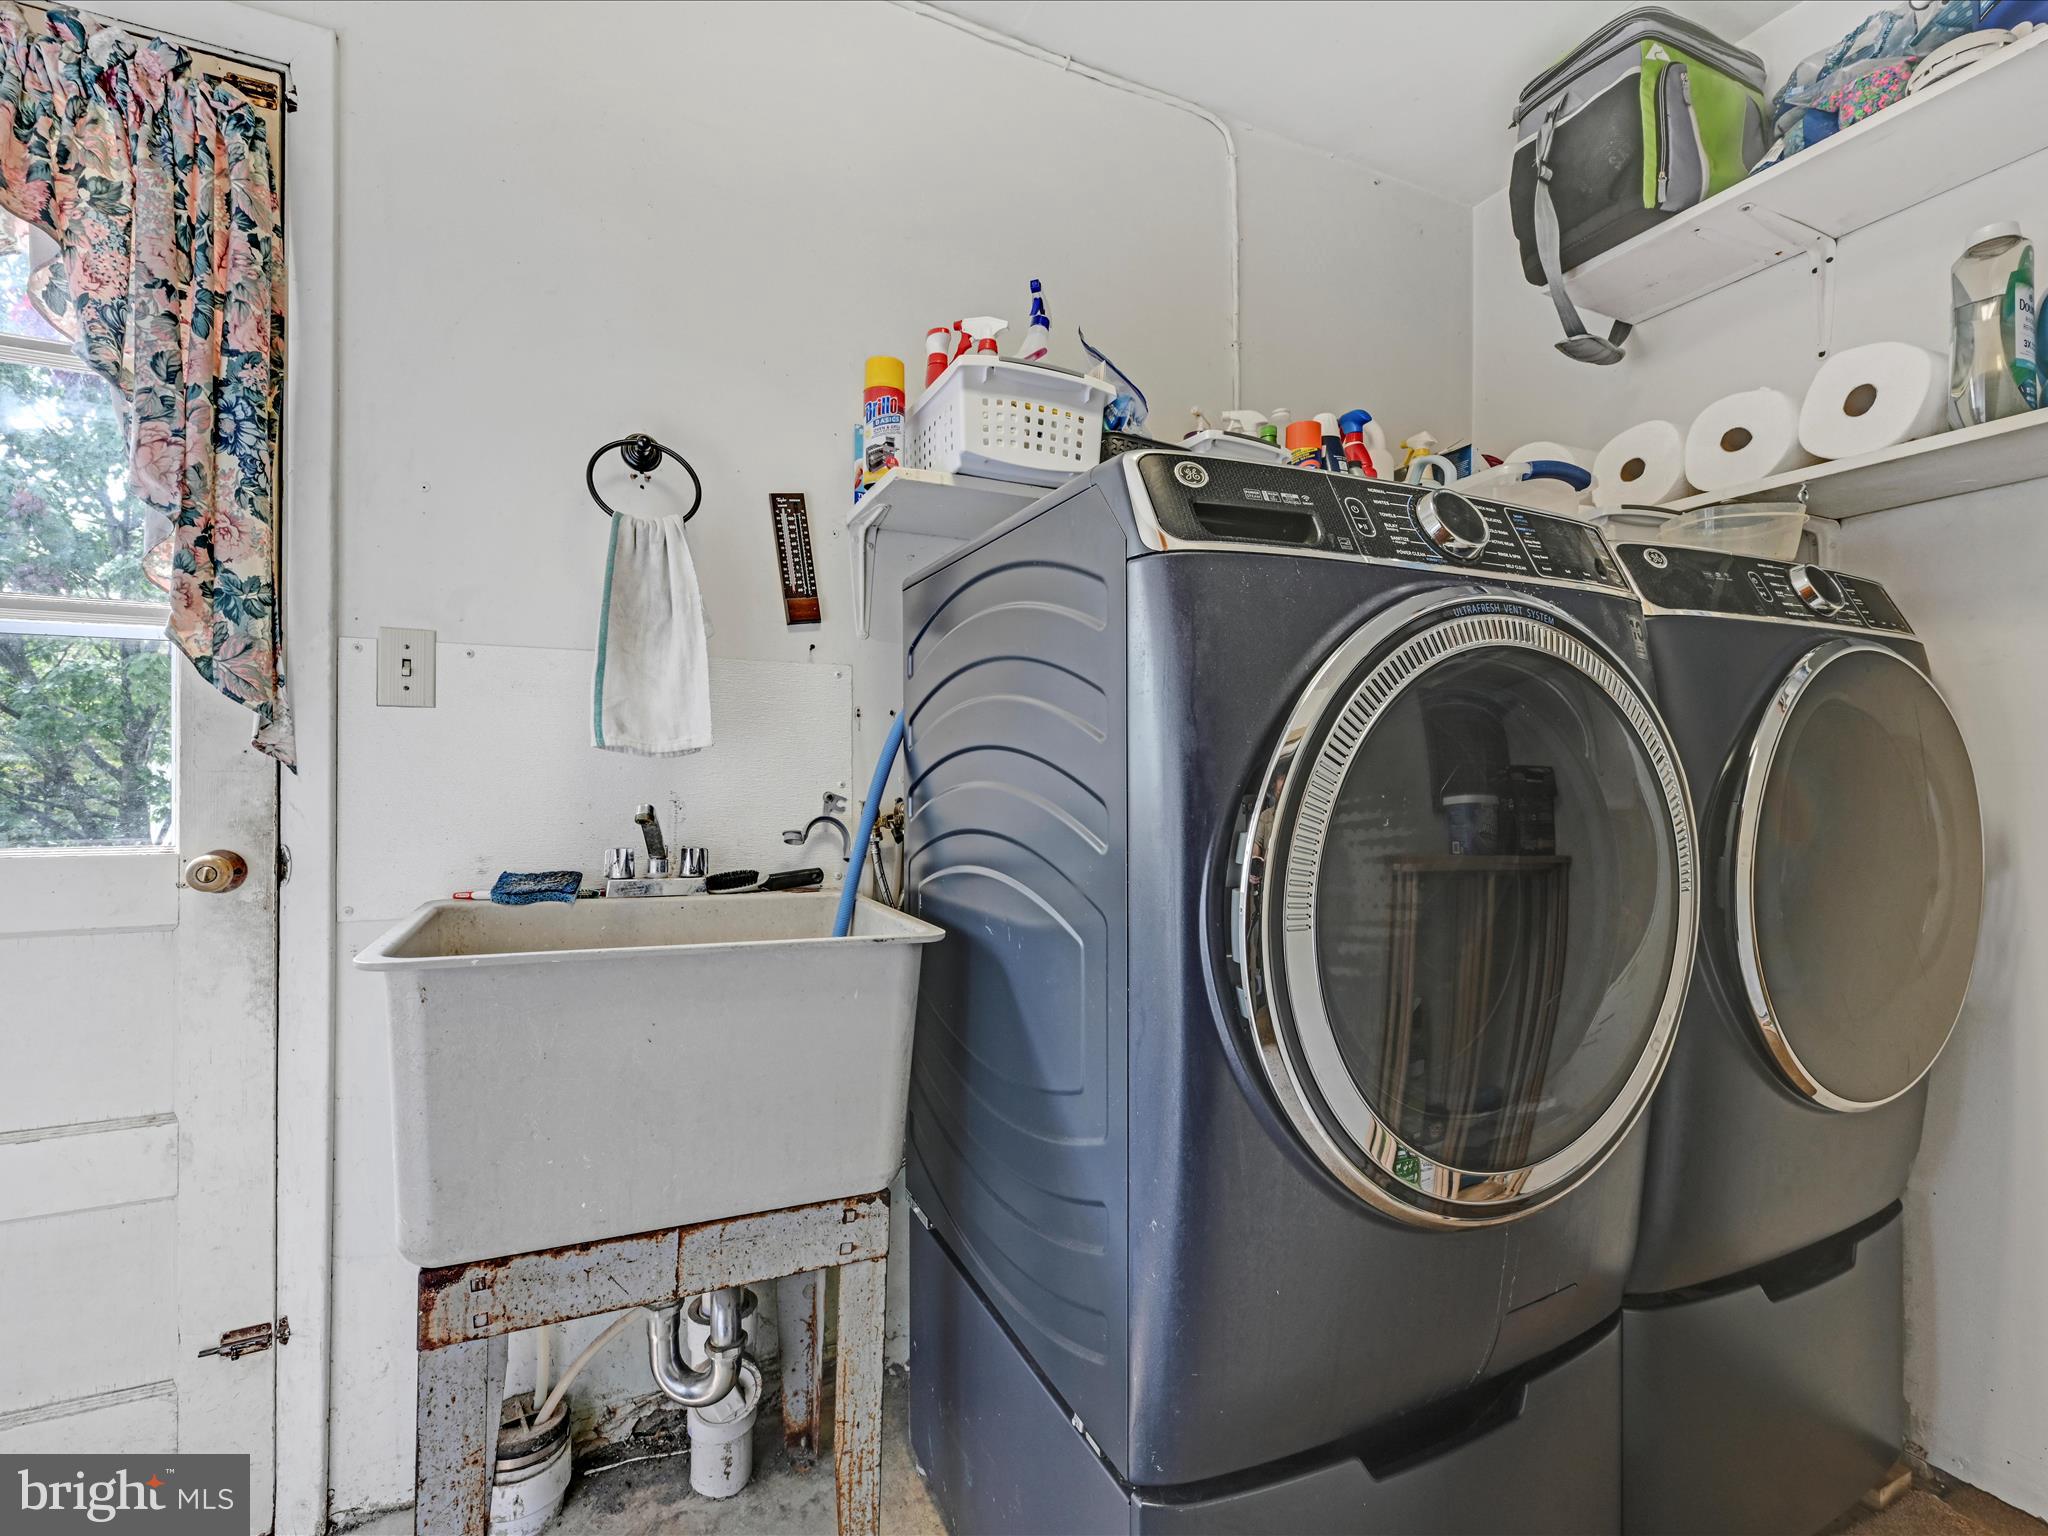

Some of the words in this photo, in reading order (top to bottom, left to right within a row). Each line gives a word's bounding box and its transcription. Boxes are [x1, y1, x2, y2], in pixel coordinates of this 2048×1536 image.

[865, 396, 899, 424] Brillo
[874, 415, 900, 427] BASICS
[1453, 603, 1501, 617] ULTRAFRESH
[1502, 604, 1523, 615] VENT
[1526, 608, 1555, 625] SYSTEM
